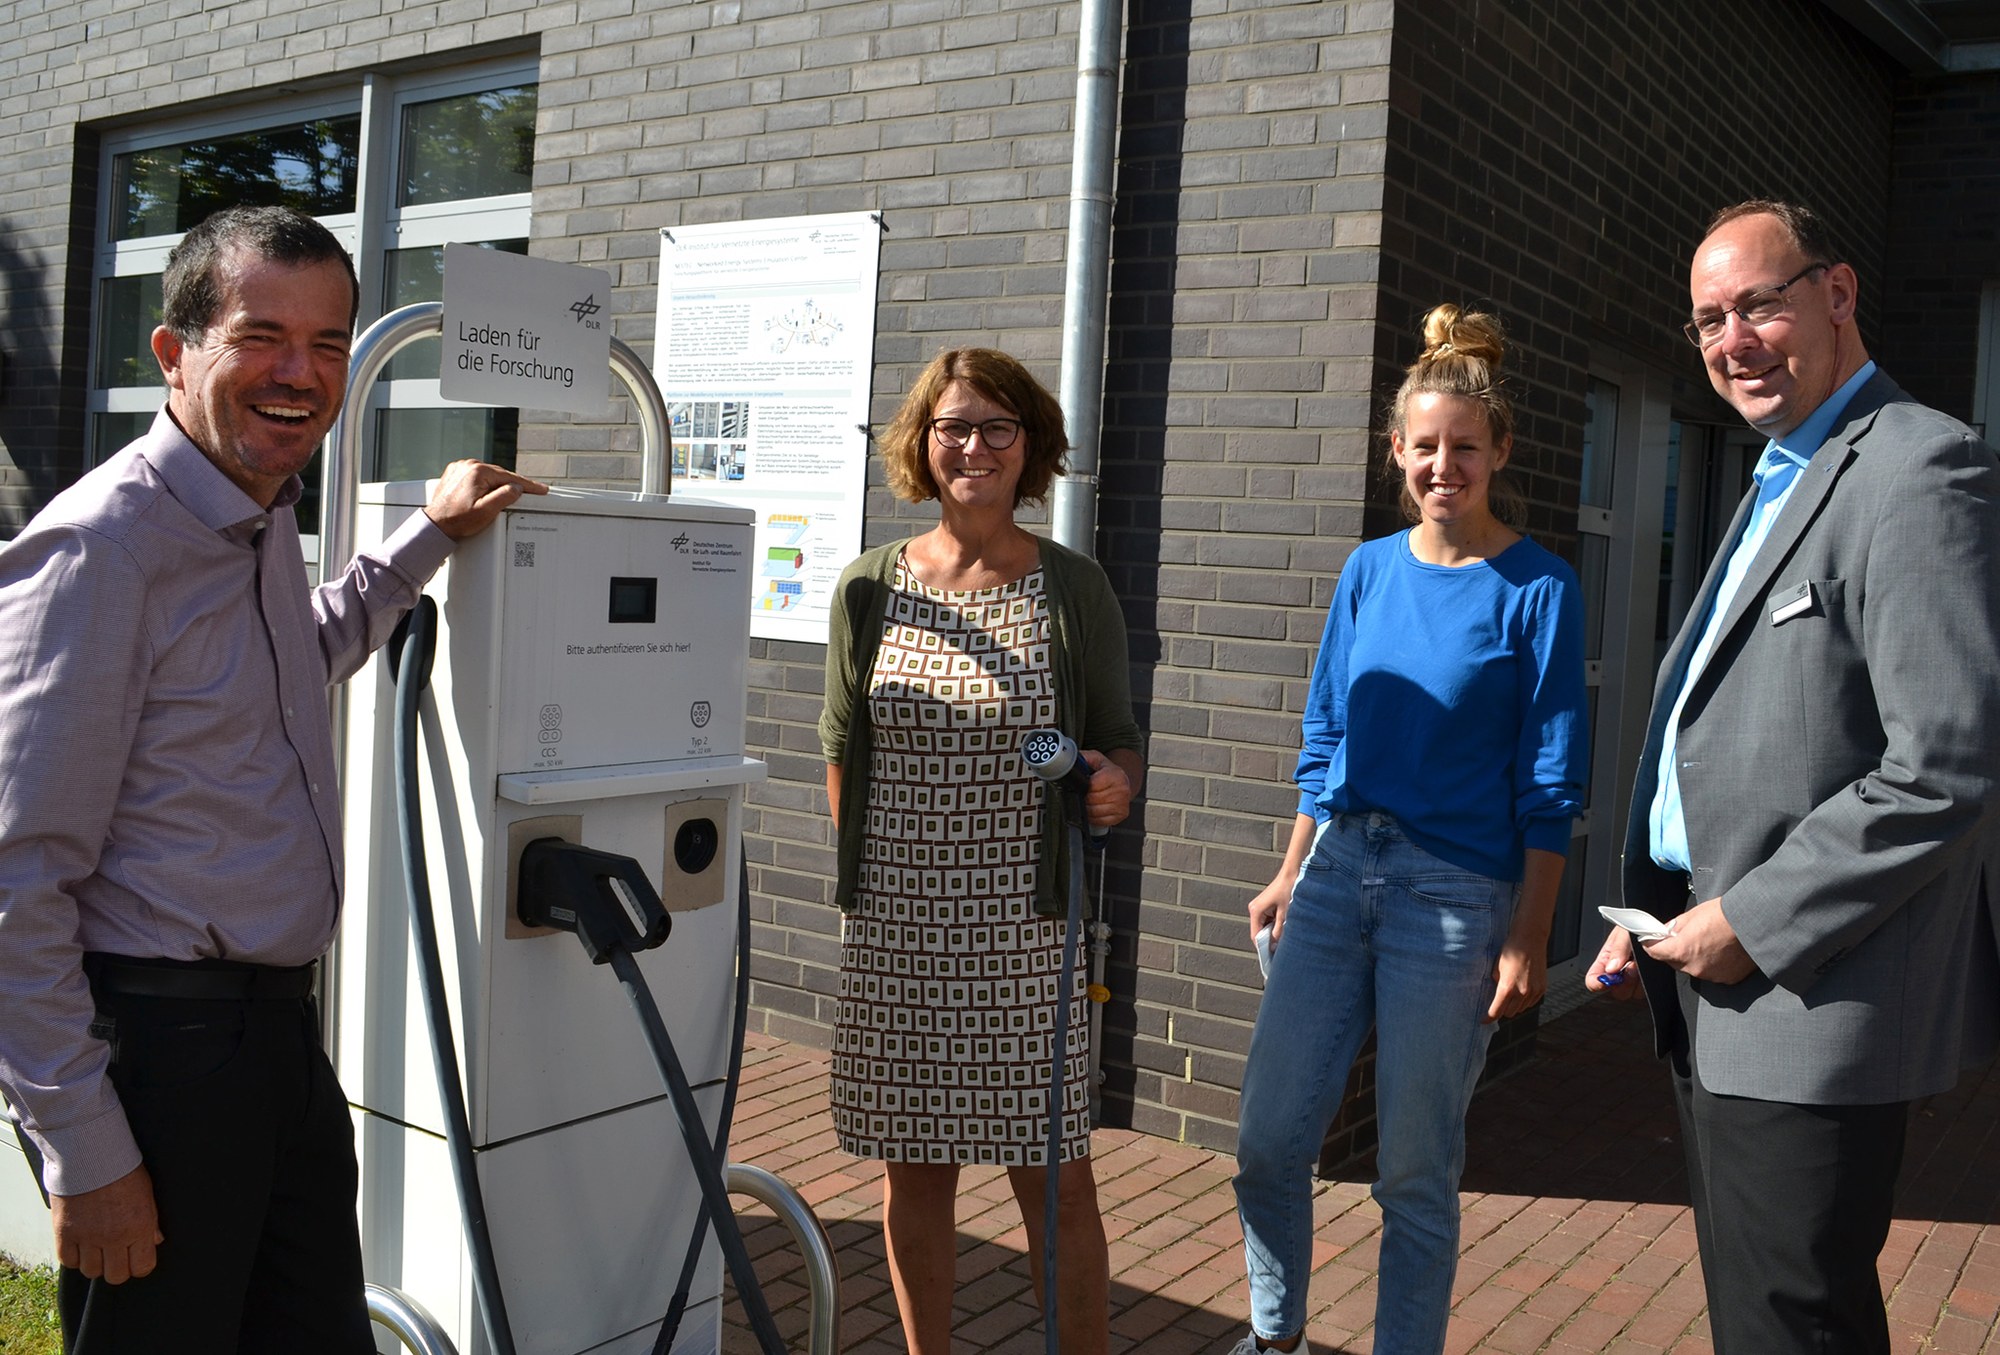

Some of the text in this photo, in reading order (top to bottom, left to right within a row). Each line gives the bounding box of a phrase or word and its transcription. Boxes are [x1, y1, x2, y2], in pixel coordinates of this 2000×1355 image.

[585, 320, 601, 330] DLR
[459, 321, 541, 351] Laden für
[457, 349, 574, 388] die Forschung
[566, 641, 691, 655] Bitte authentifizieren Sie sich hier!
[691, 736, 708, 748] Typ 2
[541, 747, 557, 758] CCS
